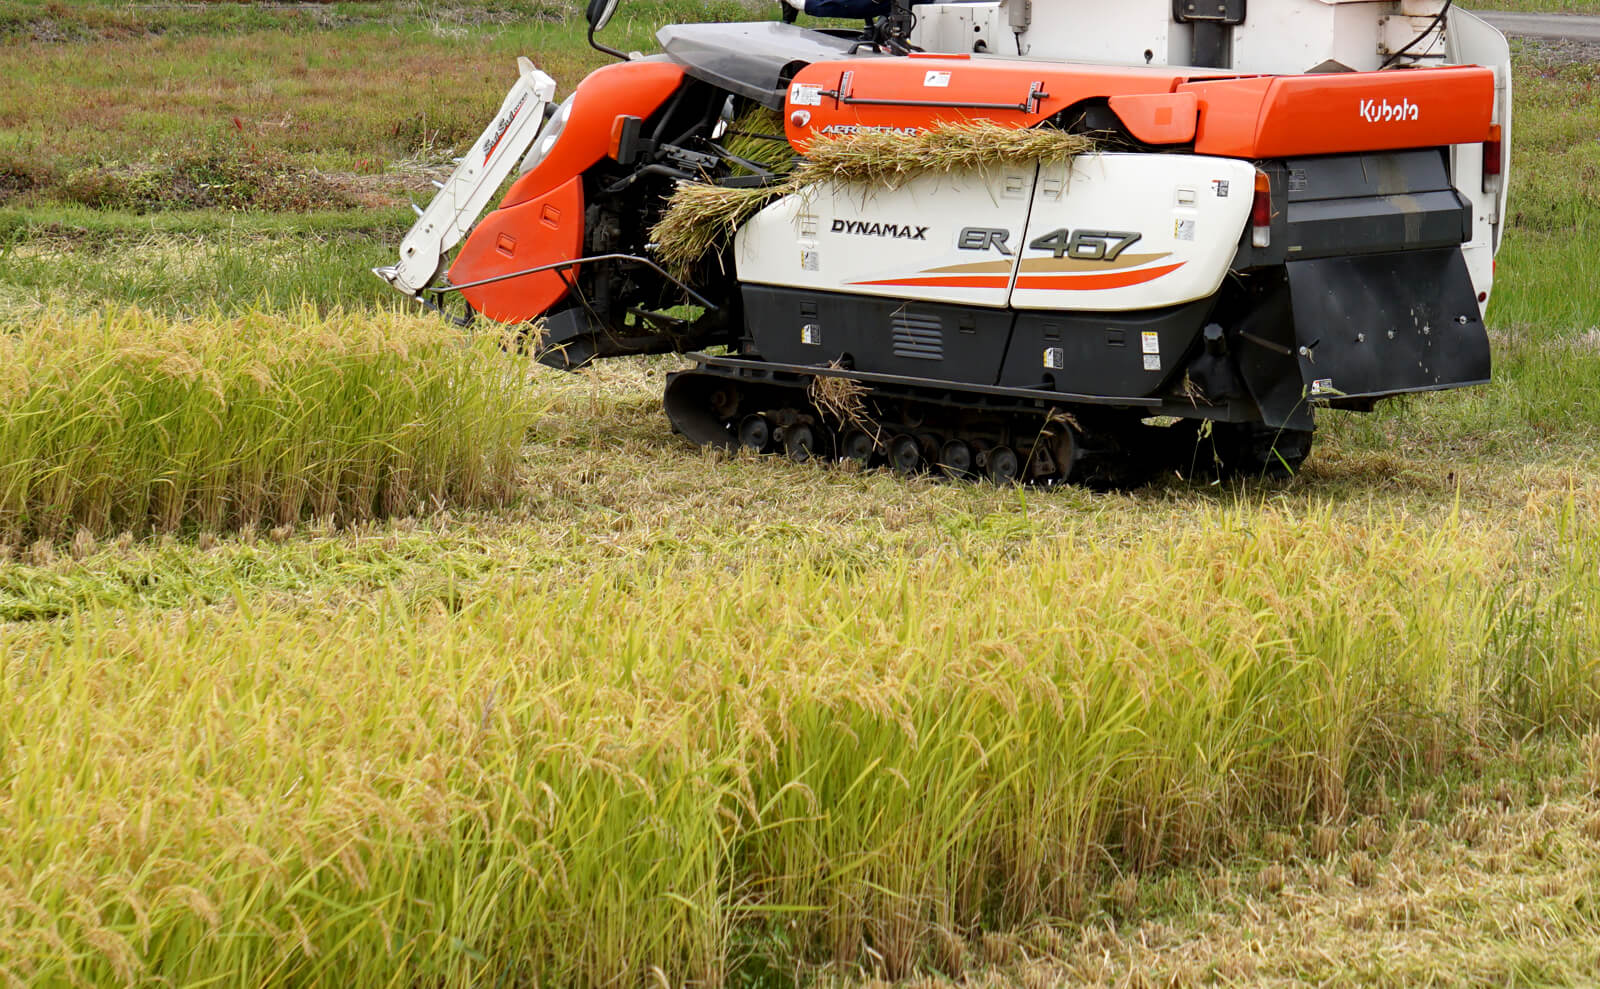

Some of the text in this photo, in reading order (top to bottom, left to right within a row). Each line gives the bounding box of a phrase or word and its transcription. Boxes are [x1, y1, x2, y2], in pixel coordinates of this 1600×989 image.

[1360, 97, 1419, 122] Kubota
[821, 124, 917, 138] AEROSTAR
[831, 218, 930, 241] DYNAMAX
[958, 226, 1015, 257] ER
[1029, 228, 1142, 262] 467
